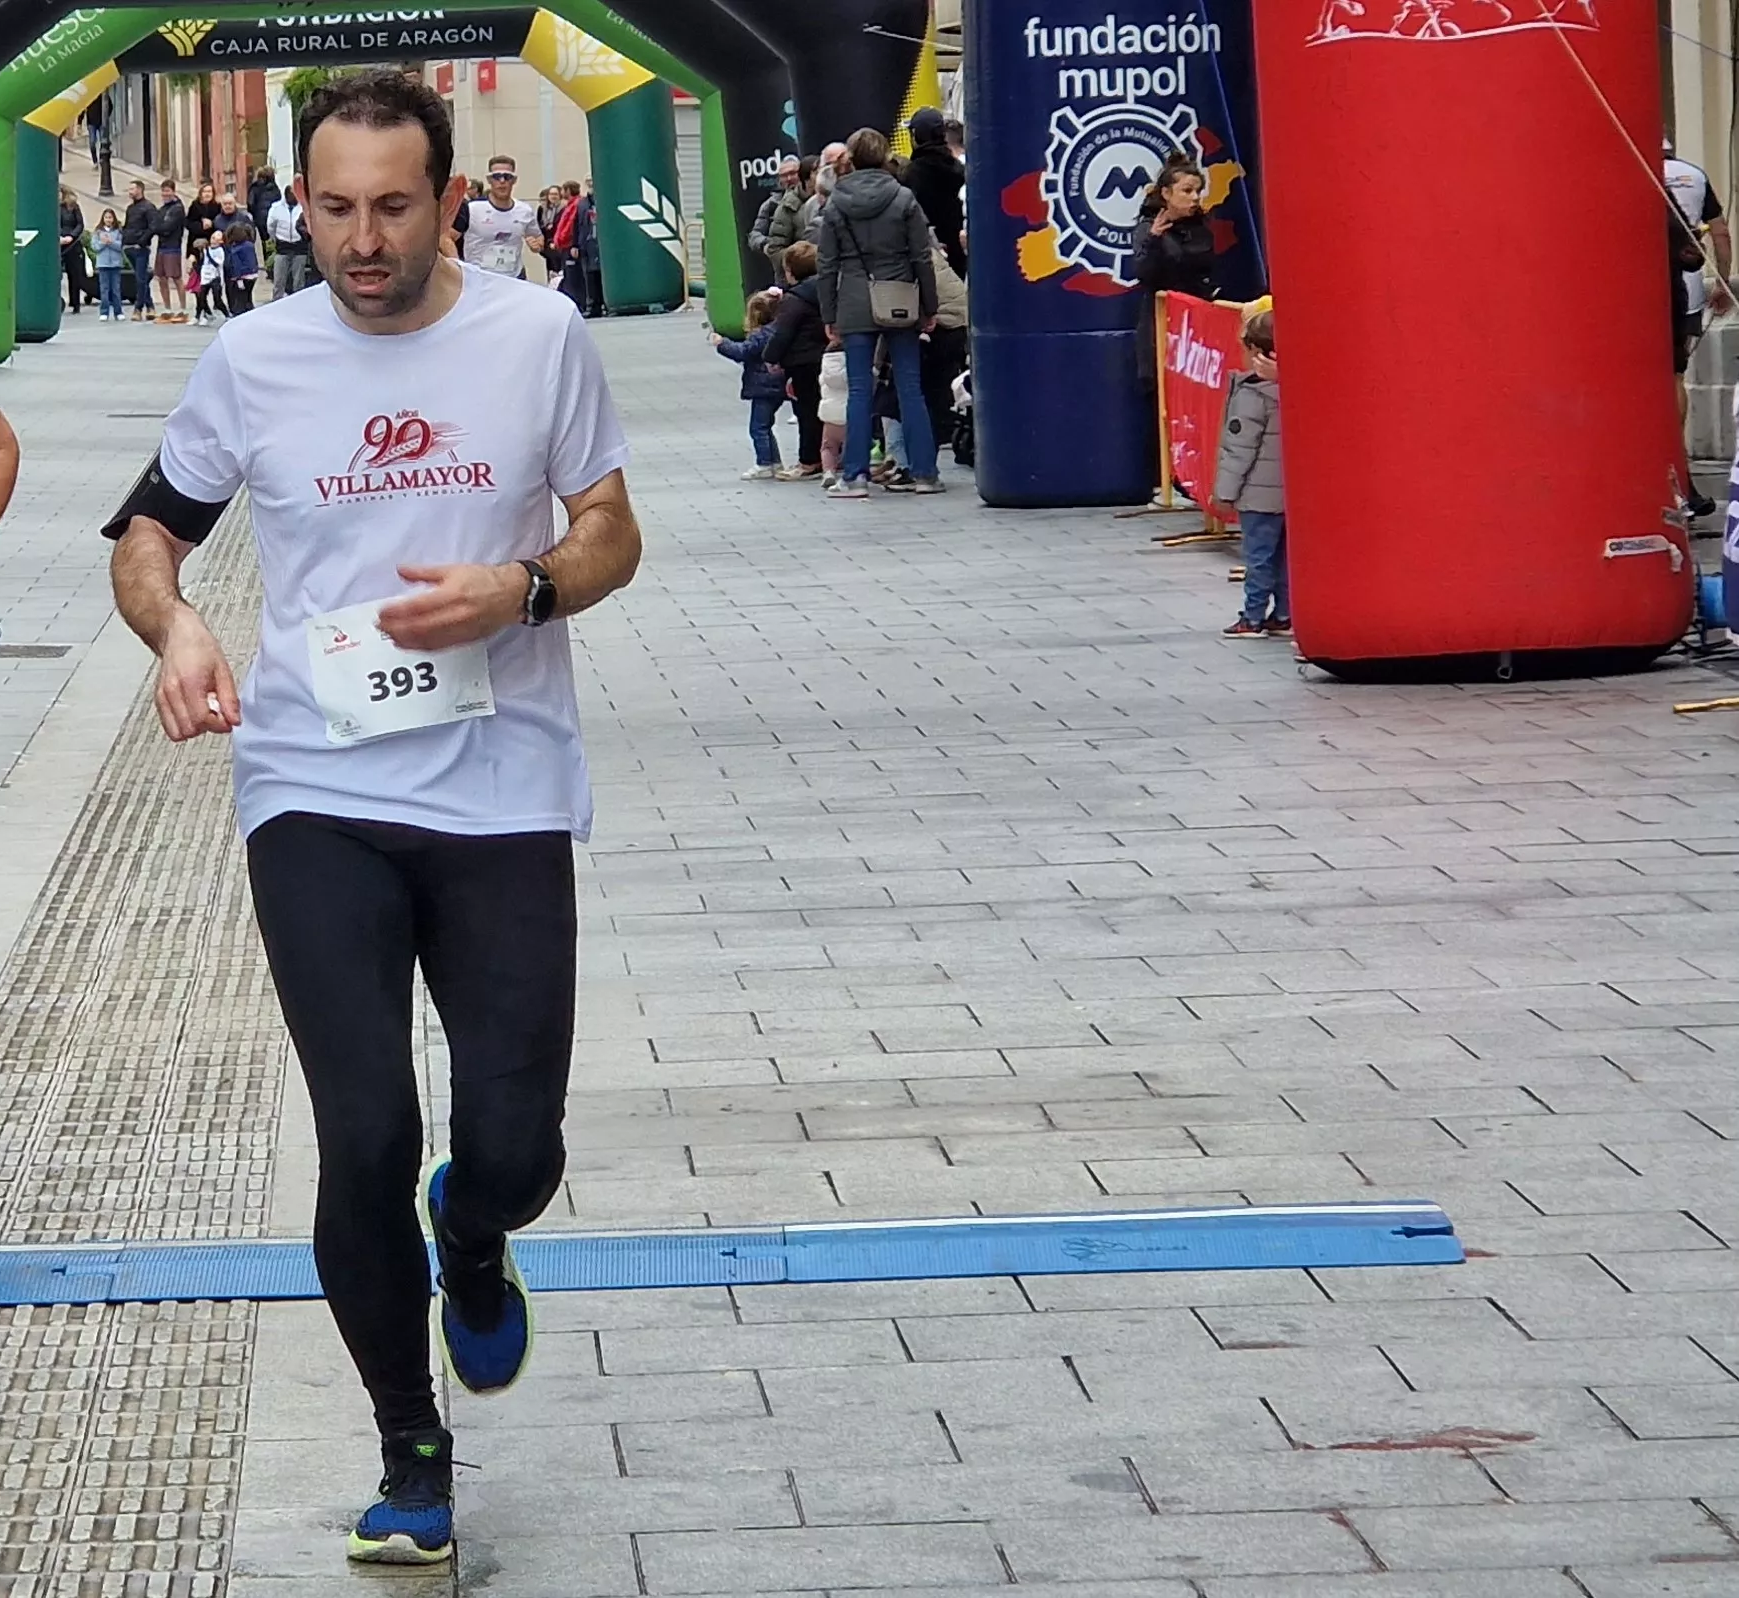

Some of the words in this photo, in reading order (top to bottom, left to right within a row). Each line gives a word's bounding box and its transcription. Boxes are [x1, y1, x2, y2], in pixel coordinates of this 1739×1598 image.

[211, 37, 269, 55] CAJA
[277, 33, 352, 52] RURAL
[360, 31, 389, 48] DE
[398, 24, 495, 46] ARAGÓN
[1024, 12, 1221, 57] fundación
[1058, 56, 1187, 104] mupol
[364, 415, 432, 463] 90
[314, 462, 496, 501] VILLAMAYOR
[367, 661, 439, 702] 393
